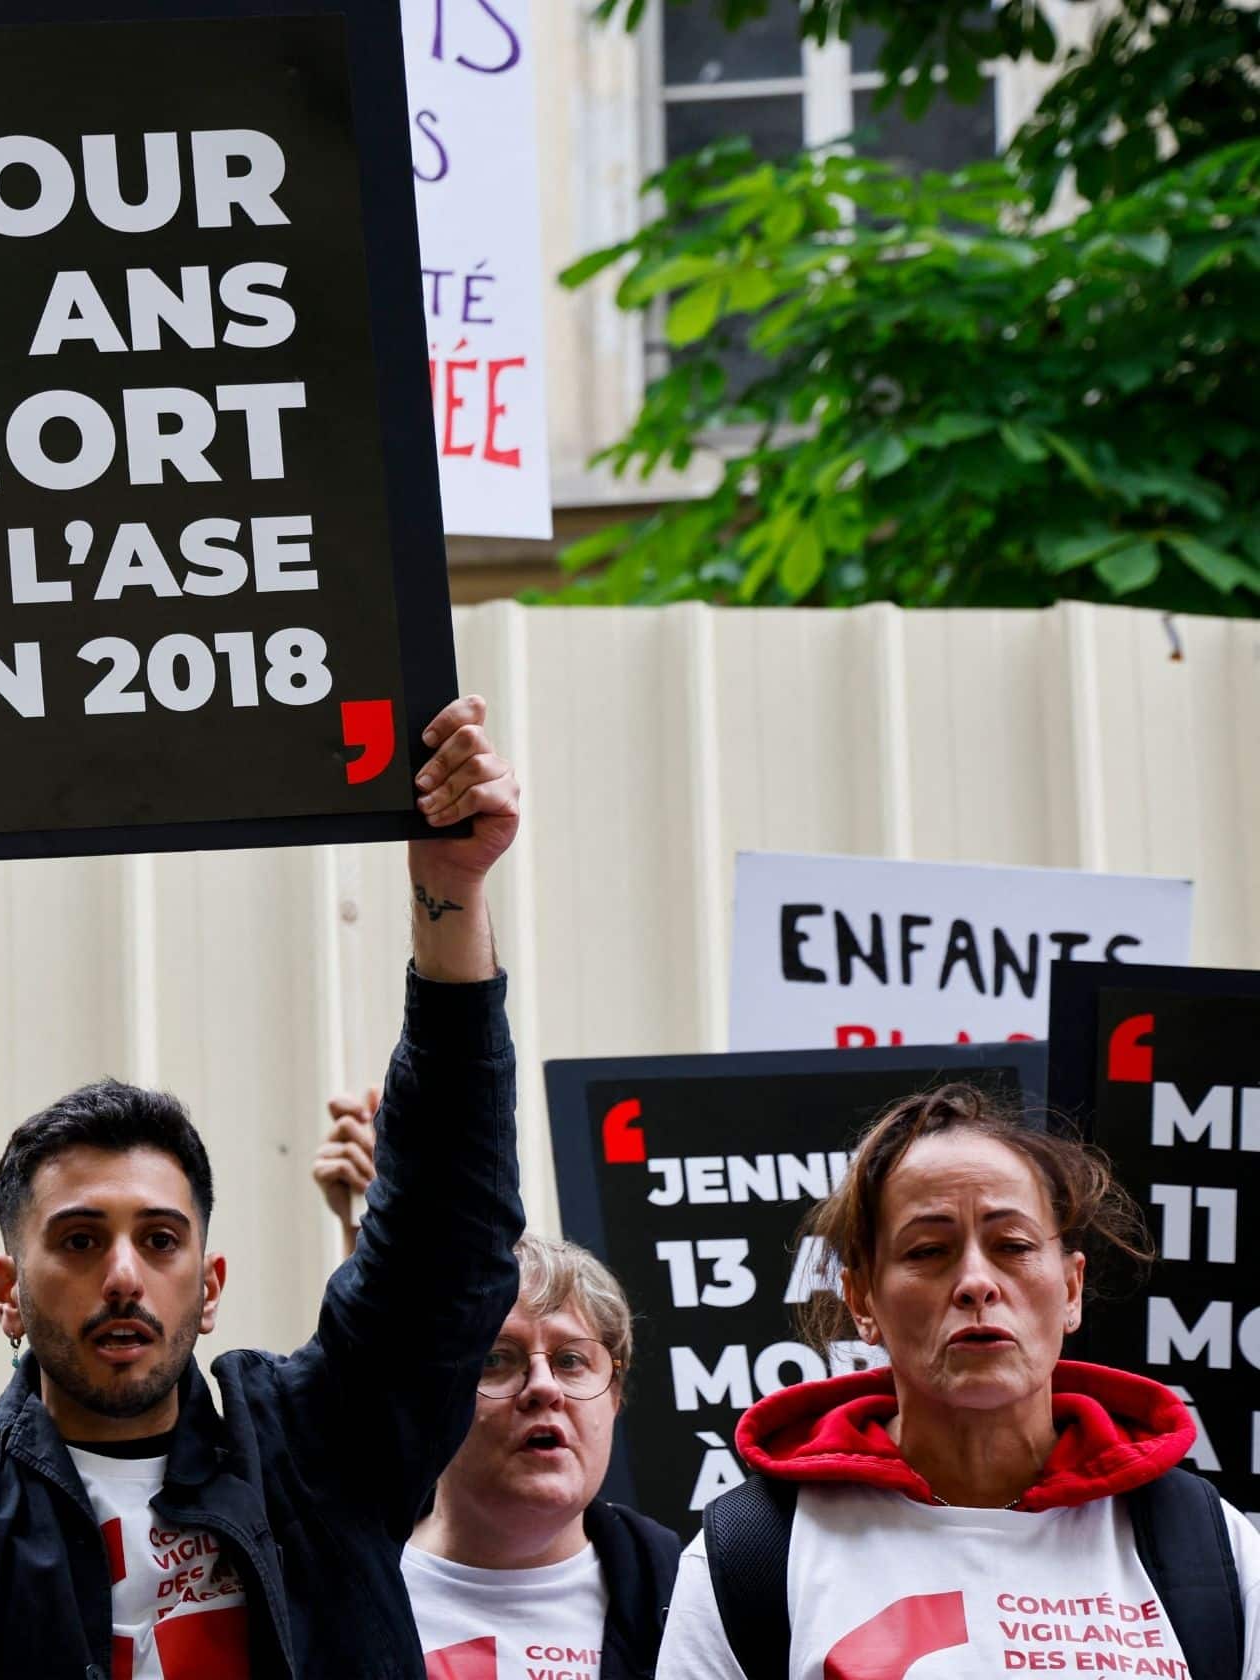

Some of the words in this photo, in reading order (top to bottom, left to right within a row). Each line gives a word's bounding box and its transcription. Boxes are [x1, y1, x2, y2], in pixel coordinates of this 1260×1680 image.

[28, 262, 296, 355] ANS
[7, 514, 319, 603] L’ASE
[76, 627, 333, 715] 2018
[1151, 1184, 1237, 1264] 11
[656, 1238, 757, 1309] 13
[1147, 1296, 1260, 1370] M
[996, 1593, 1115, 1617] COMITÉ
[1119, 1600, 1161, 1622] DE
[998, 1621, 1165, 1649] VIGILANCE
[1004, 1649, 1067, 1671] DES
